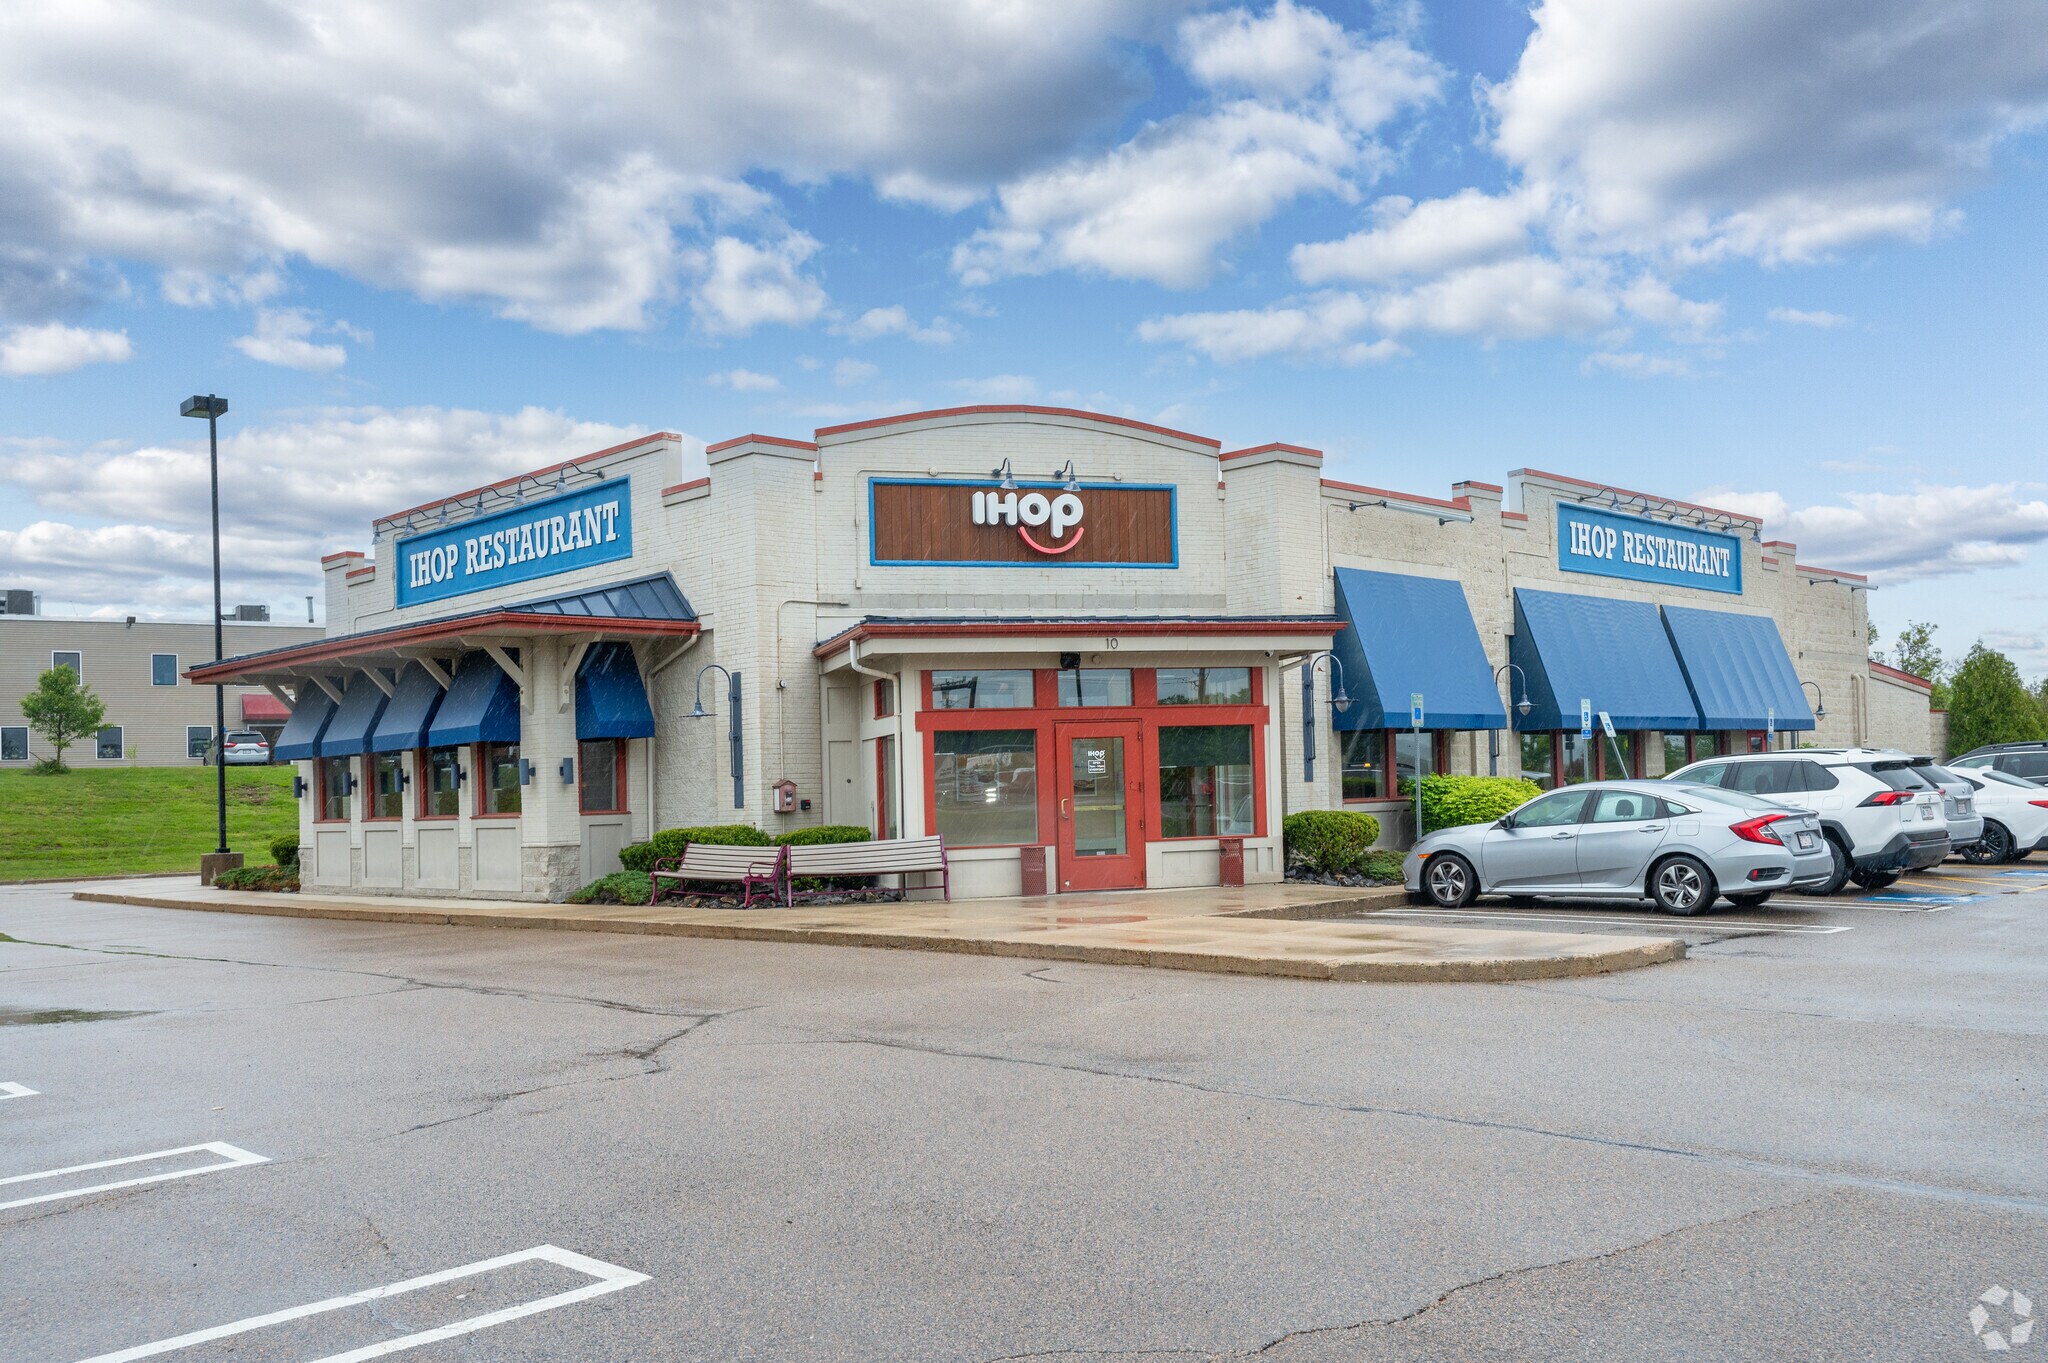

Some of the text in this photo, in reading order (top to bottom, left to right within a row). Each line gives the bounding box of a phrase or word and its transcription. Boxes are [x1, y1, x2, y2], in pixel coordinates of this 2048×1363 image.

[410, 500, 620, 589] IHOP RESTAURANT
[1569, 521, 1730, 578] IHOP RESTAURANT
[1105, 637, 1119, 650] 10
